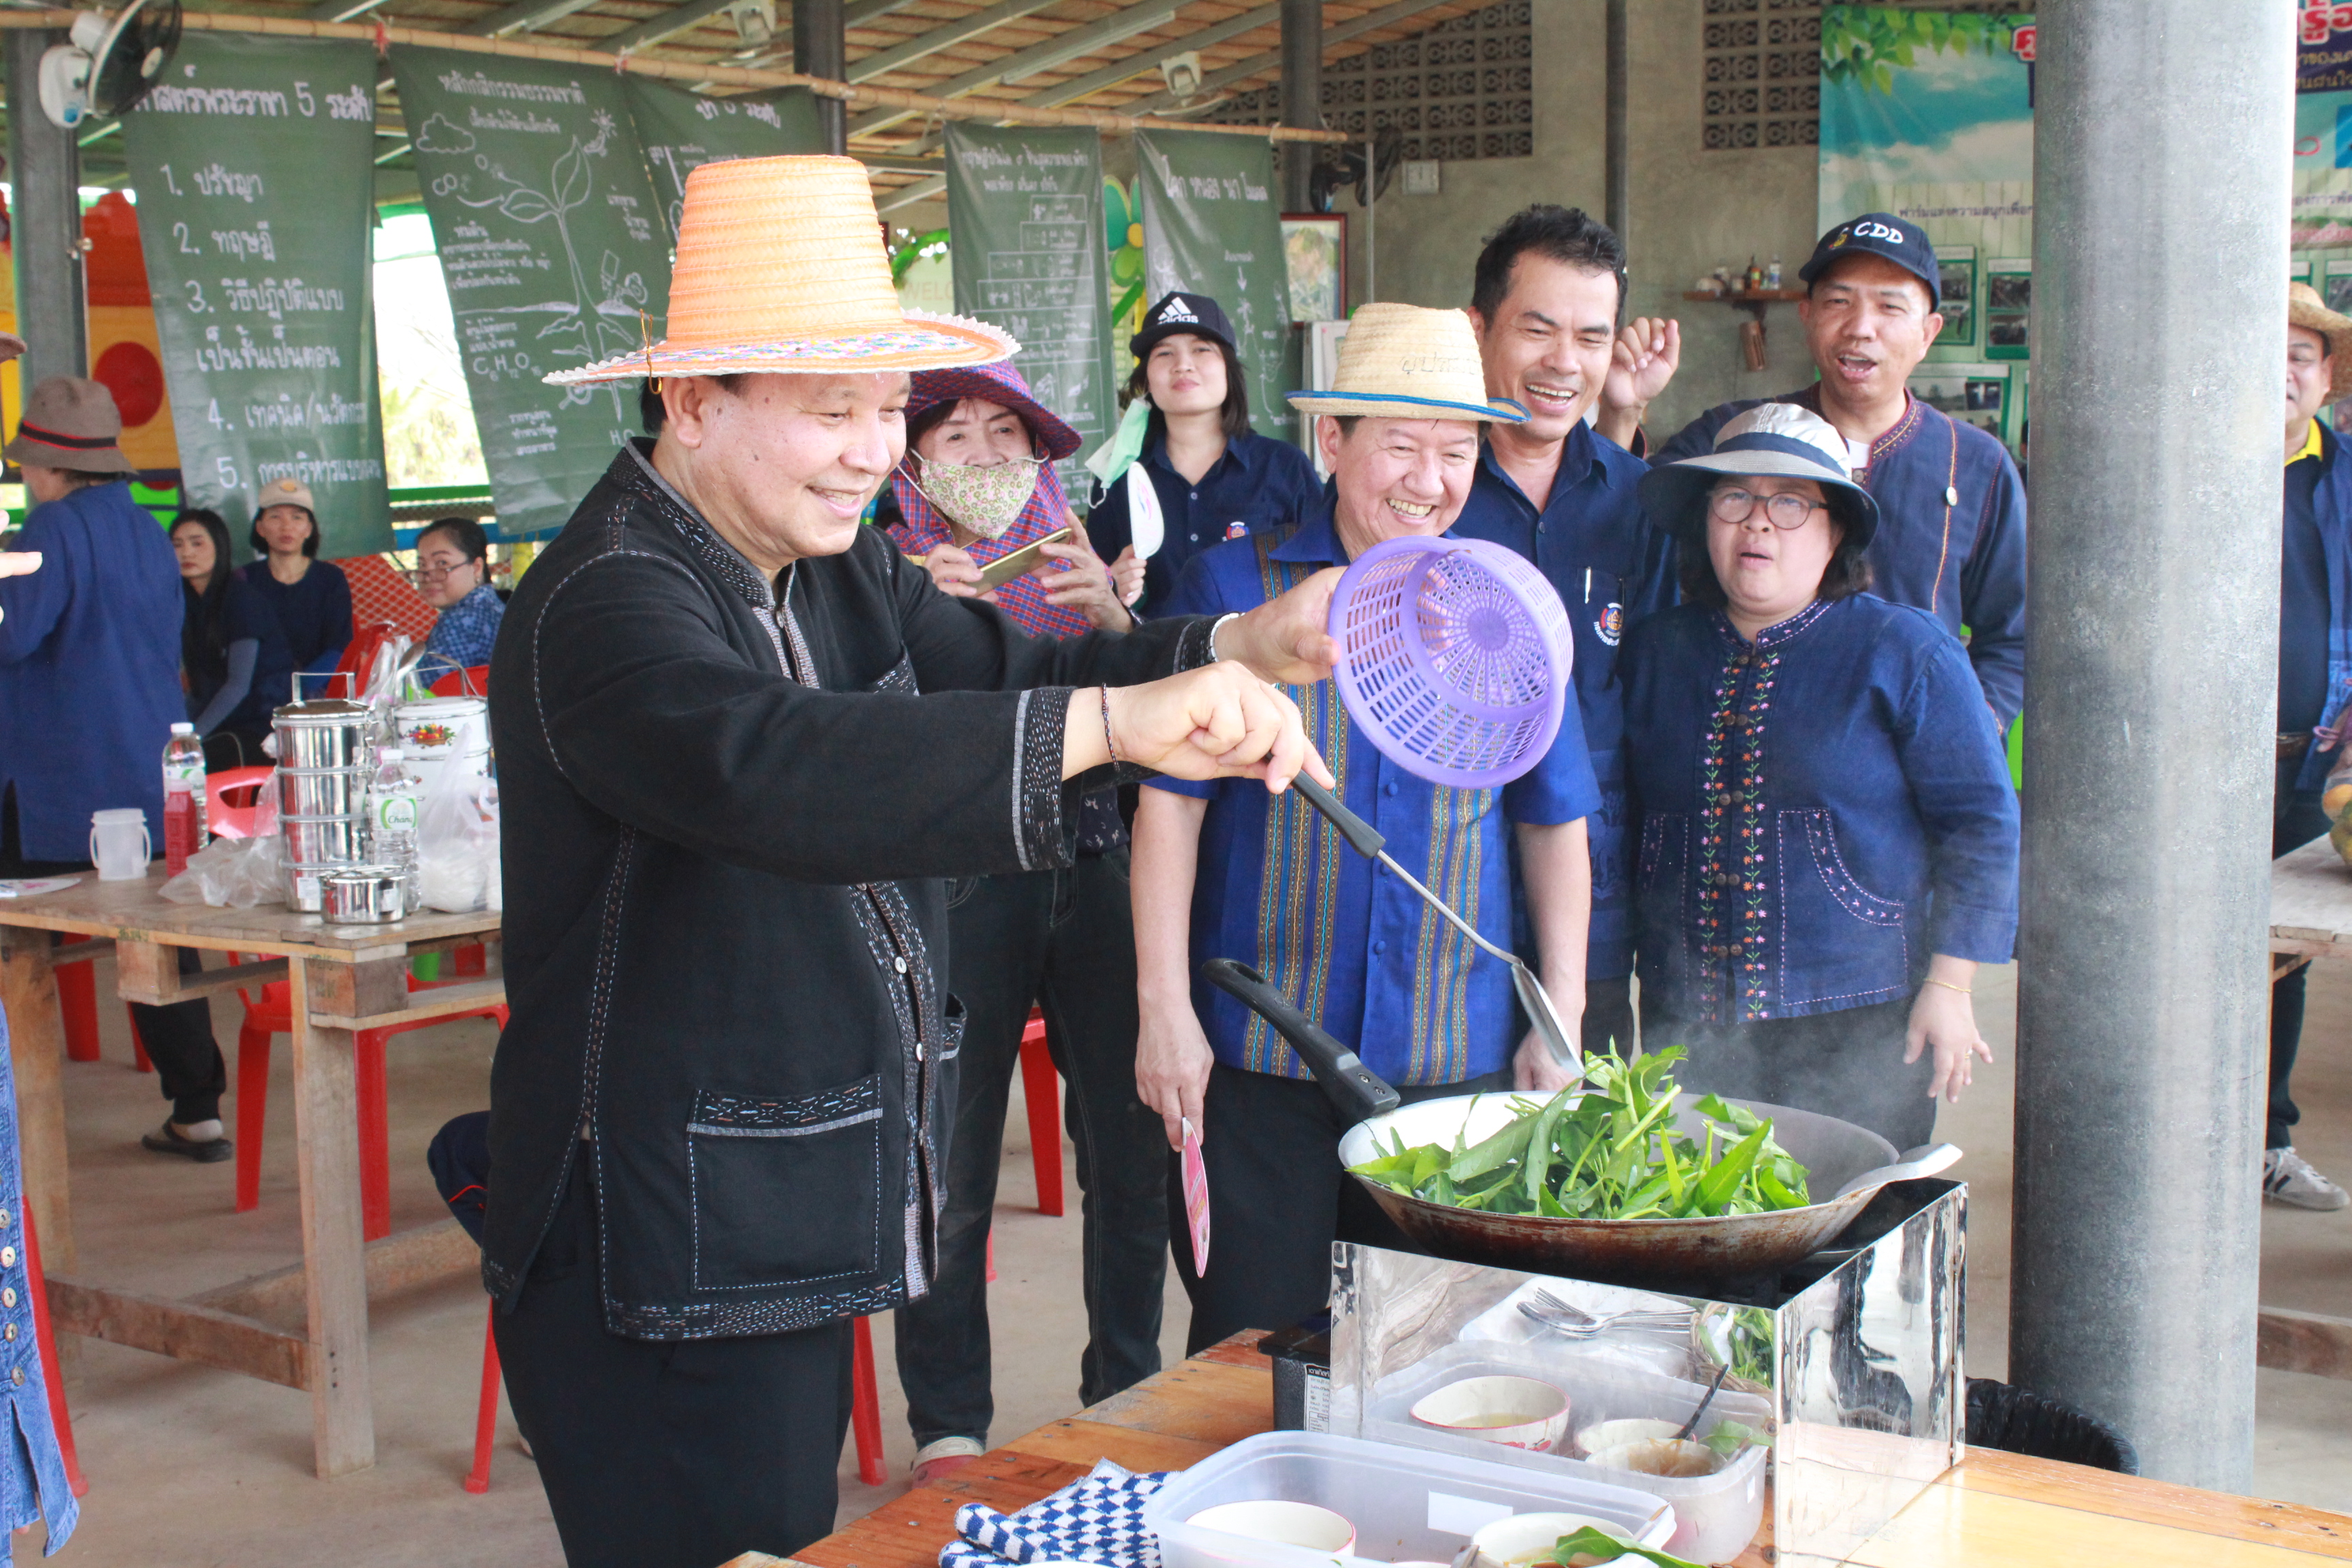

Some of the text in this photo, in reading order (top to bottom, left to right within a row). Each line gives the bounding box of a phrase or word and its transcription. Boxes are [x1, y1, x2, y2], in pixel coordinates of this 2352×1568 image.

[295, 82, 316, 116] 5
[160, 163, 264, 203] 1. ปรัชญา
[173, 220, 276, 263] 2. ทฤษฎี
[1854, 221, 1904, 244] CDD
[185, 280, 216, 314] 3.
[208, 397, 235, 430] 4.
[216, 456, 248, 489] 5.
